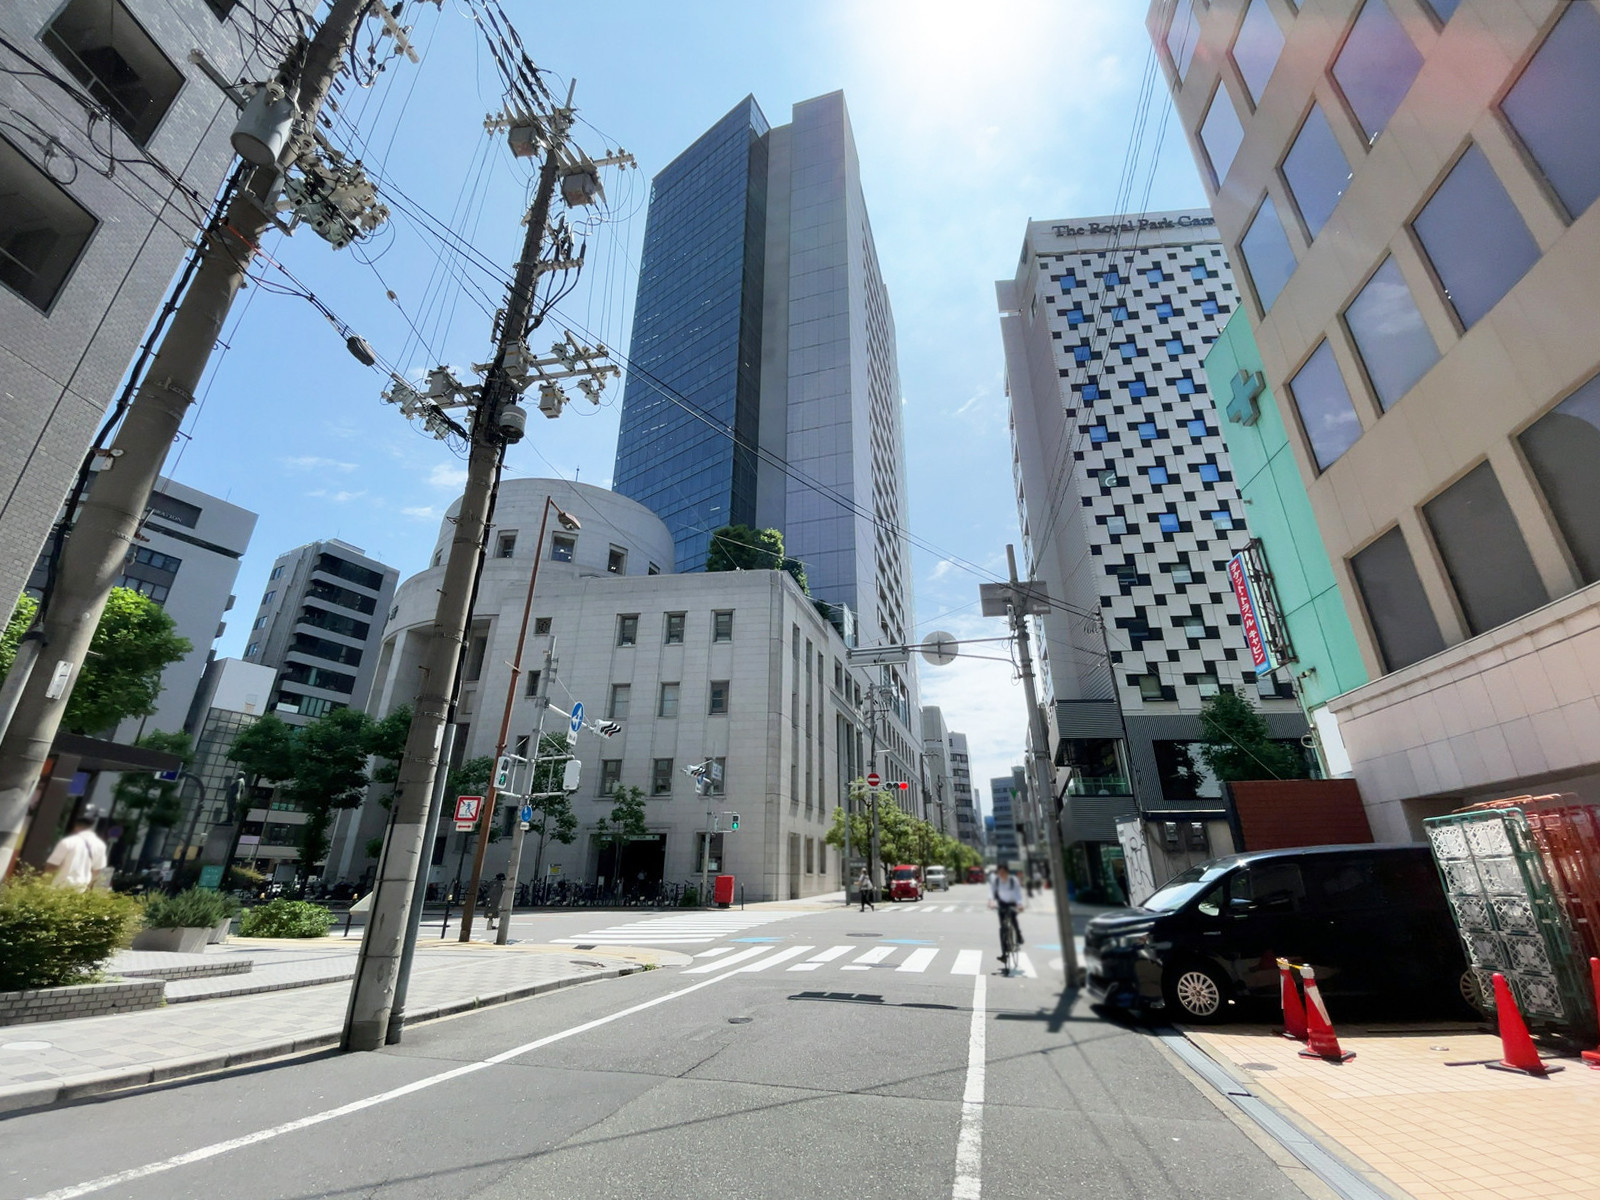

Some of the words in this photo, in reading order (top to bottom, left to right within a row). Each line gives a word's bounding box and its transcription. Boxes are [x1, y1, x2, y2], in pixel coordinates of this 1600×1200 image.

[1052, 225, 1085, 237] The
[1088, 219, 1135, 235] Royal
[1137, 217, 1175, 231] Park
[1248, 630, 1264, 664] キャビン
